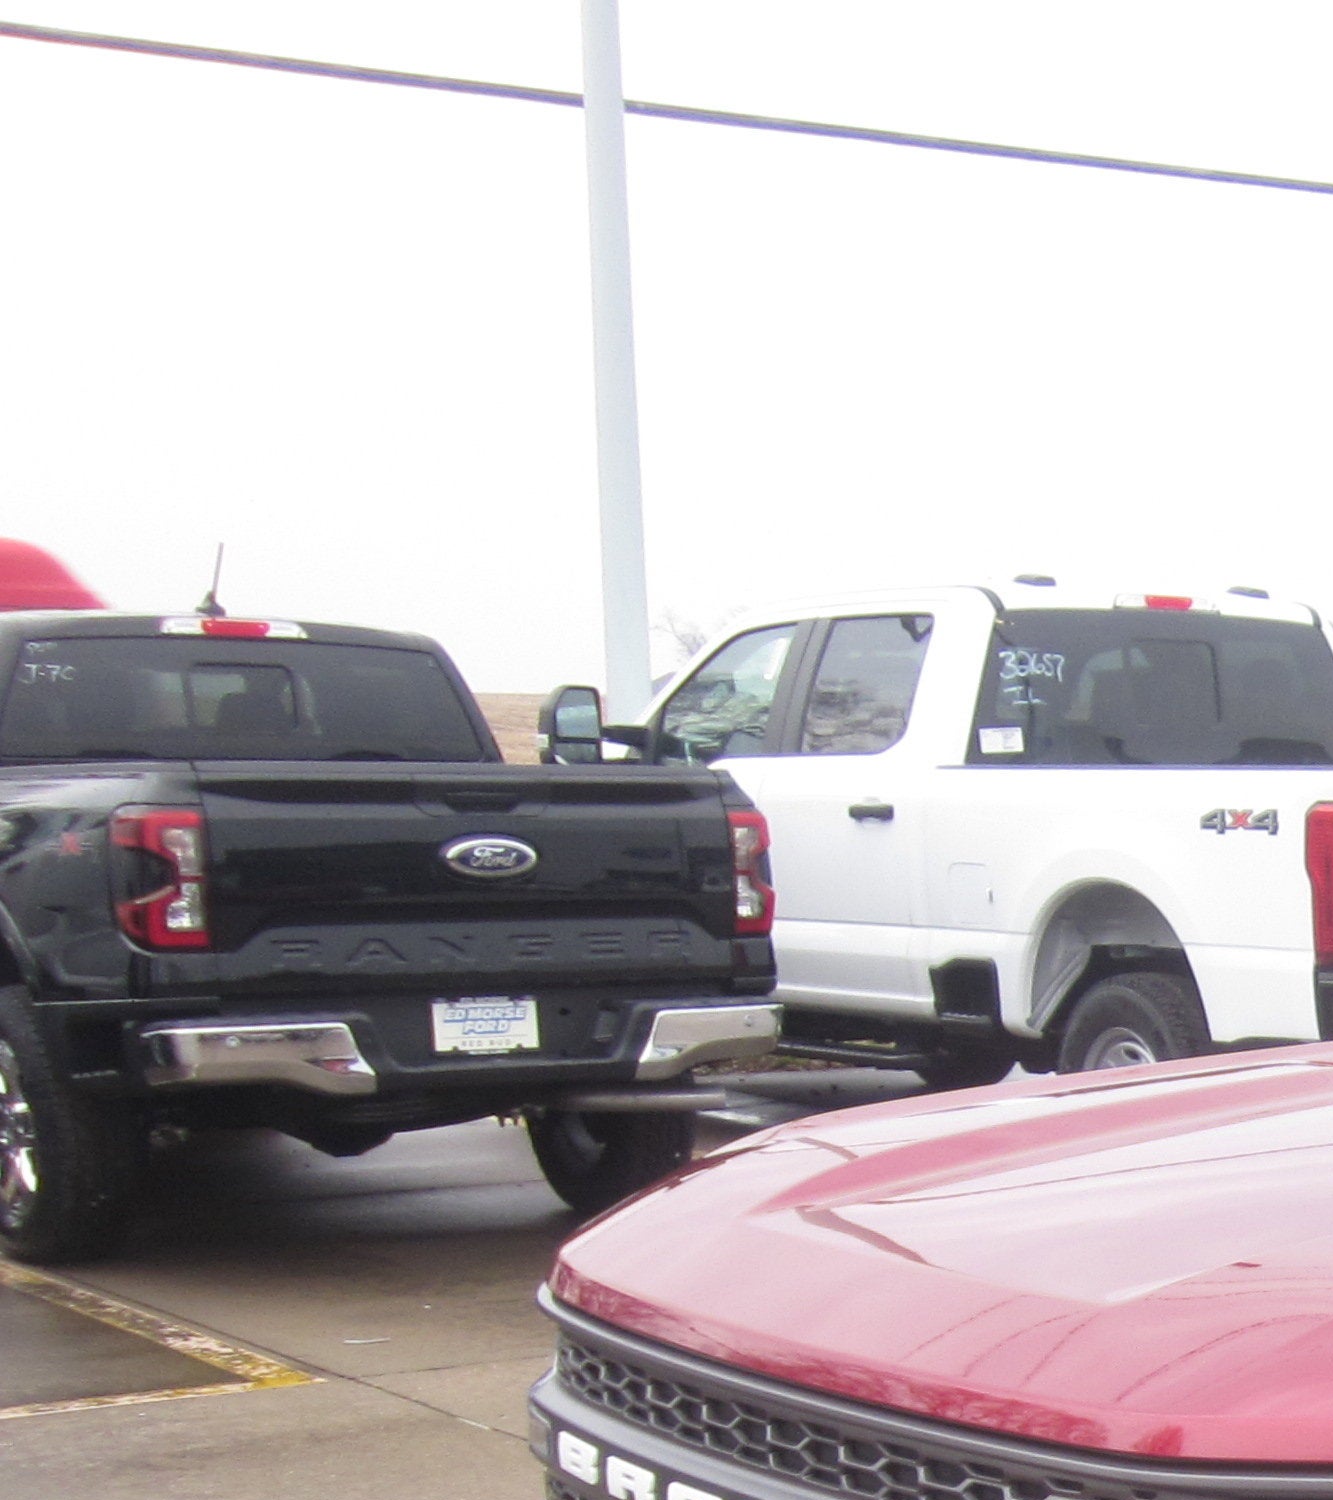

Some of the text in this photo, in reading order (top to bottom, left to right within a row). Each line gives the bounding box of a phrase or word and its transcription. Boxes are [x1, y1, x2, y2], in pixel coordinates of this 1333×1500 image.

[470, 846, 518, 867] Ford
[270, 930, 690, 968] RANGER
[467, 1005, 527, 1020] MORSE
[462, 1020, 509, 1034] FORD
